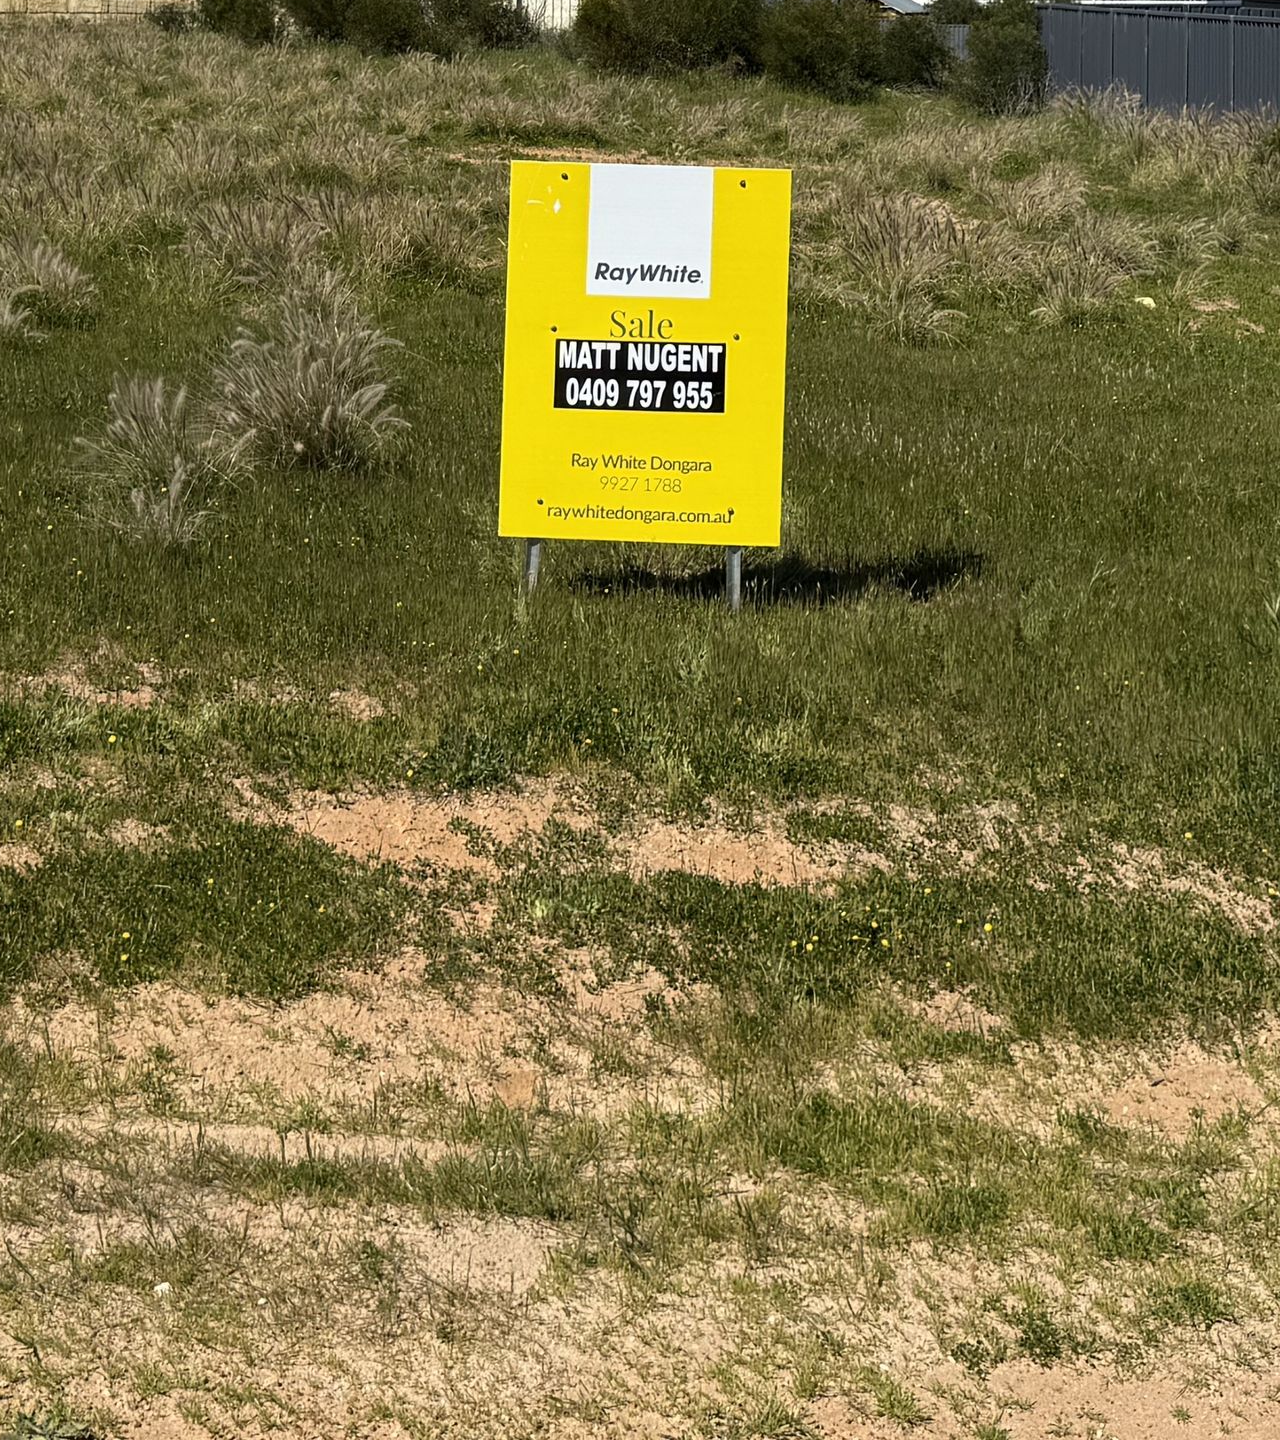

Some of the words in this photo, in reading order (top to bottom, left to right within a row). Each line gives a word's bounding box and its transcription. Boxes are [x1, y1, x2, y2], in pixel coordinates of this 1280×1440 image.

[610, 310, 673, 339] Sale
[558, 341, 621, 371] MATT
[627, 343, 723, 373] NUGENT
[565, 377, 619, 407] 0409
[626, 379, 666, 409] 797
[673, 381, 713, 410] 955
[571, 453, 598, 471] Ray
[602, 454, 647, 470] White
[650, 456, 712, 475] Dongara
[599, 476, 638, 492] 9927
[644, 477, 682, 493] 1788
[547, 503, 732, 525] raywhitedongara.com.au
